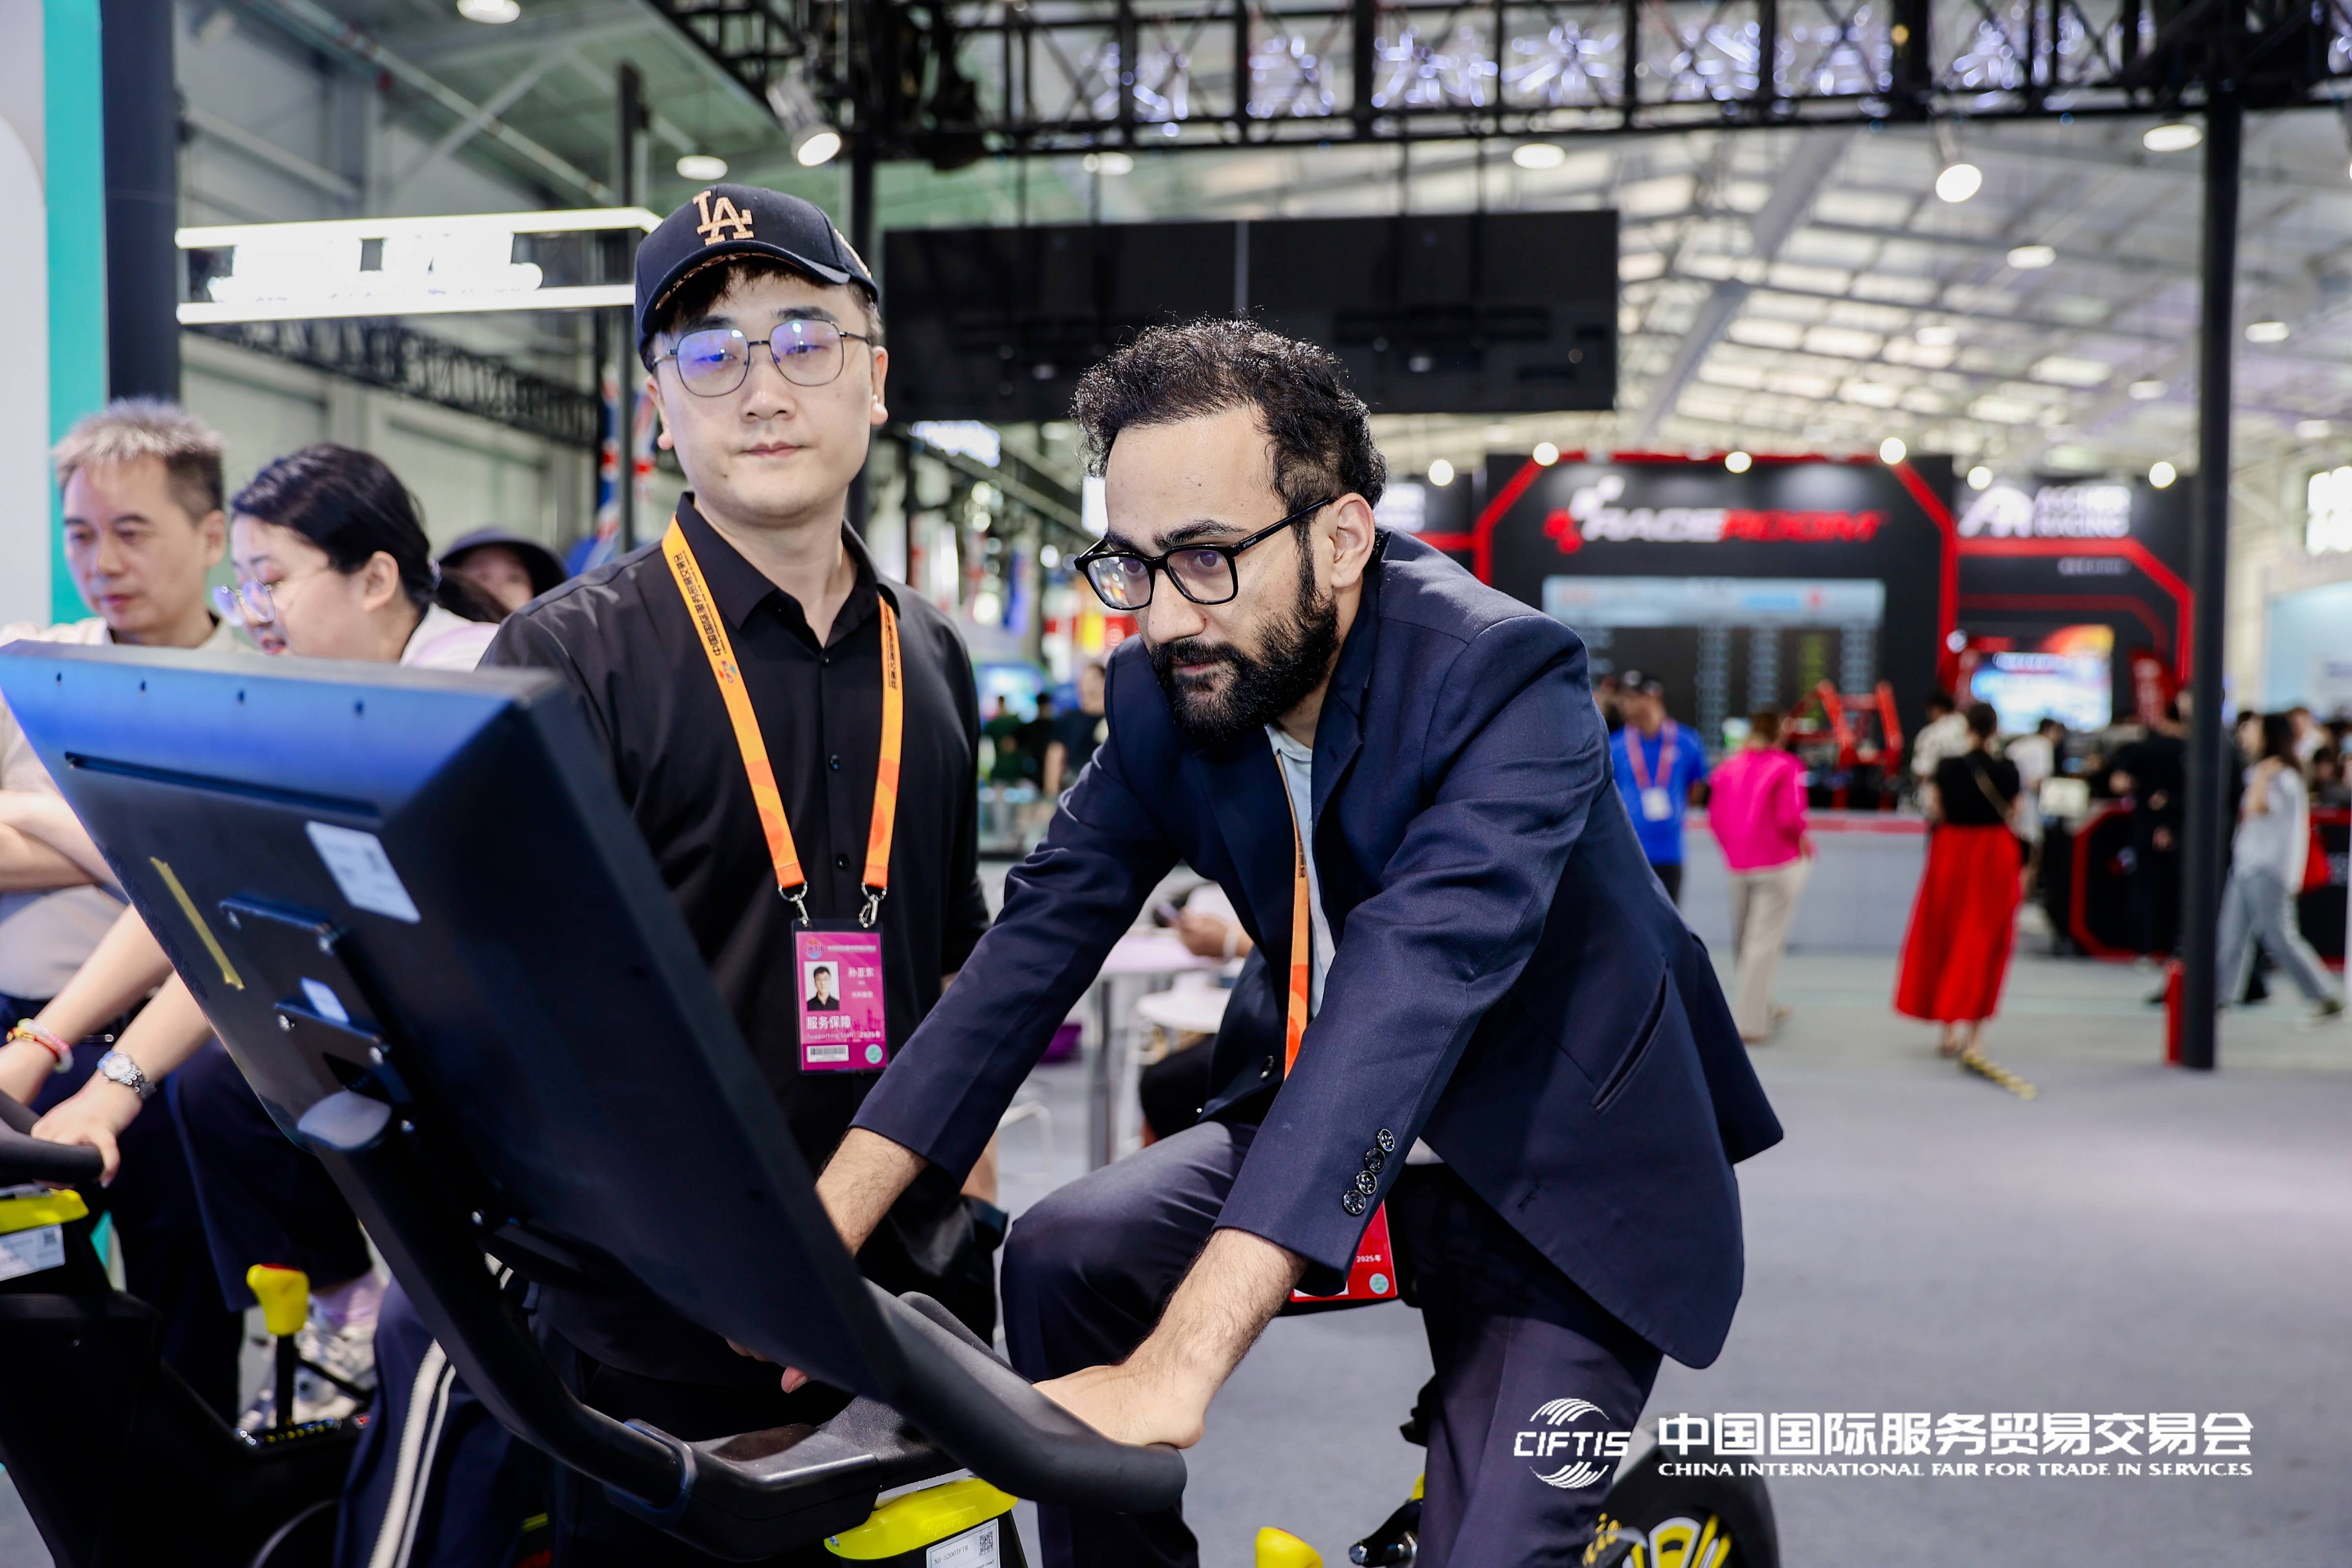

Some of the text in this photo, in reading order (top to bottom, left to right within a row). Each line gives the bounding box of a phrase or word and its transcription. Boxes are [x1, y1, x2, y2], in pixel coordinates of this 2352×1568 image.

[692, 190, 754, 246] LA
[807, 1015, 852, 1029] 服务保障
[1356, 1254, 1382, 1263] 2025年
[934, 1545, 969, 1565] NH-5200TFTR
